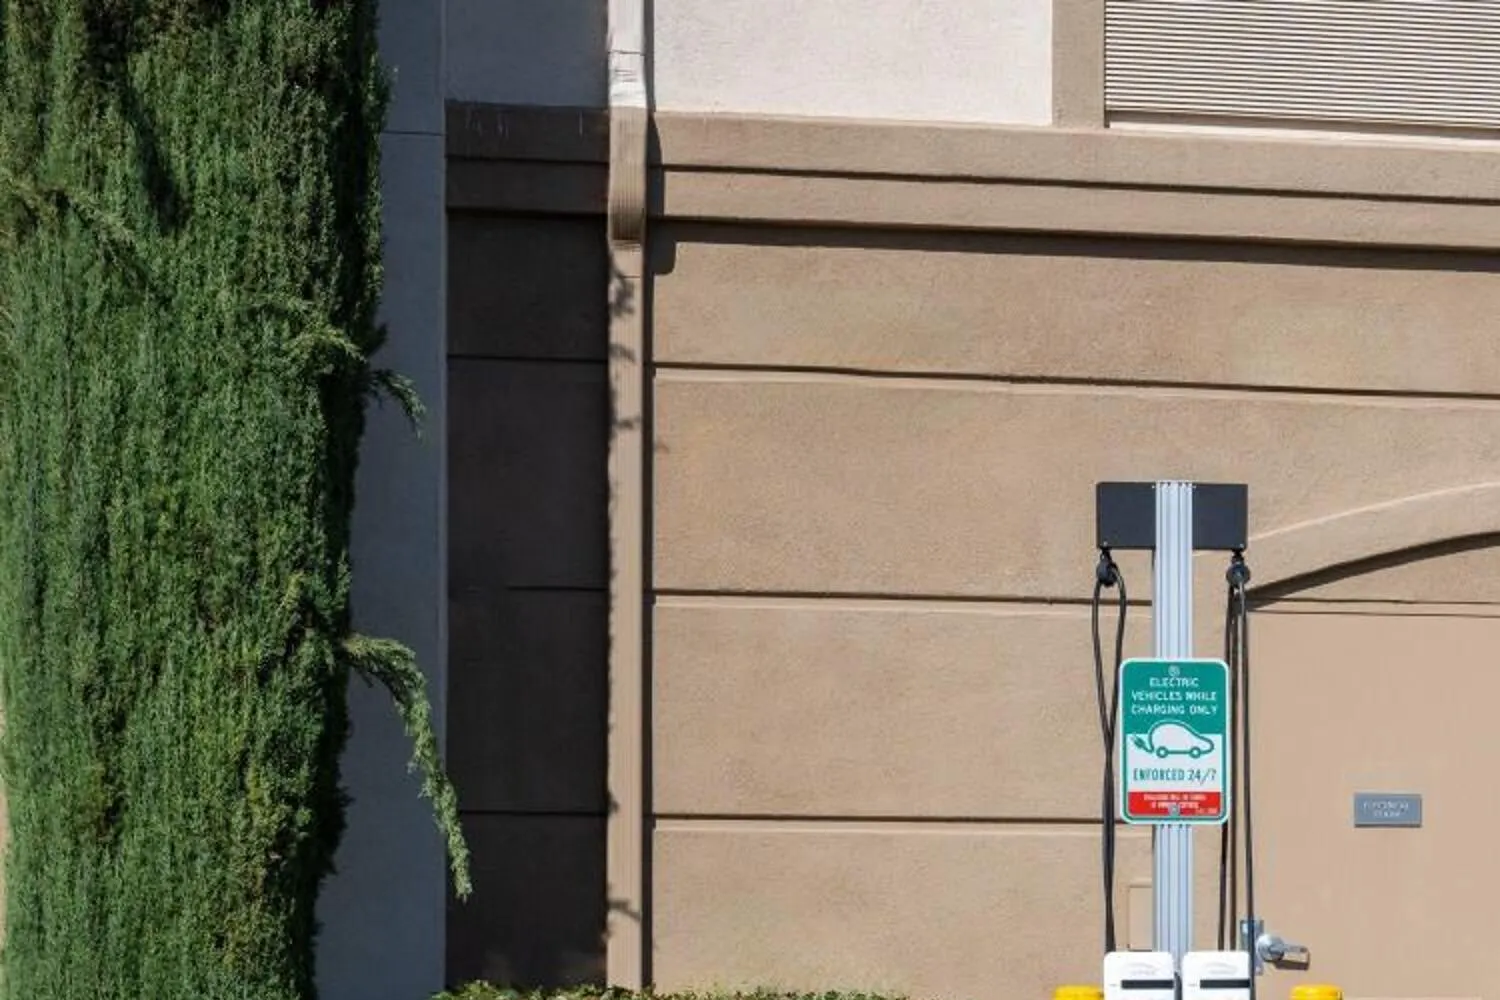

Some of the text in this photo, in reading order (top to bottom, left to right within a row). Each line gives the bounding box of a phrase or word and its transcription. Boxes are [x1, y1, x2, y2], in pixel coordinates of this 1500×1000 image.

[1149, 677, 1199, 688] ELECTRIC
[1131, 690, 1217, 701] VEHICLES WHILE
[1131, 703, 1218, 715] CHARGING ONLY
[1133, 768, 1217, 786] ENFORCED 24/7
